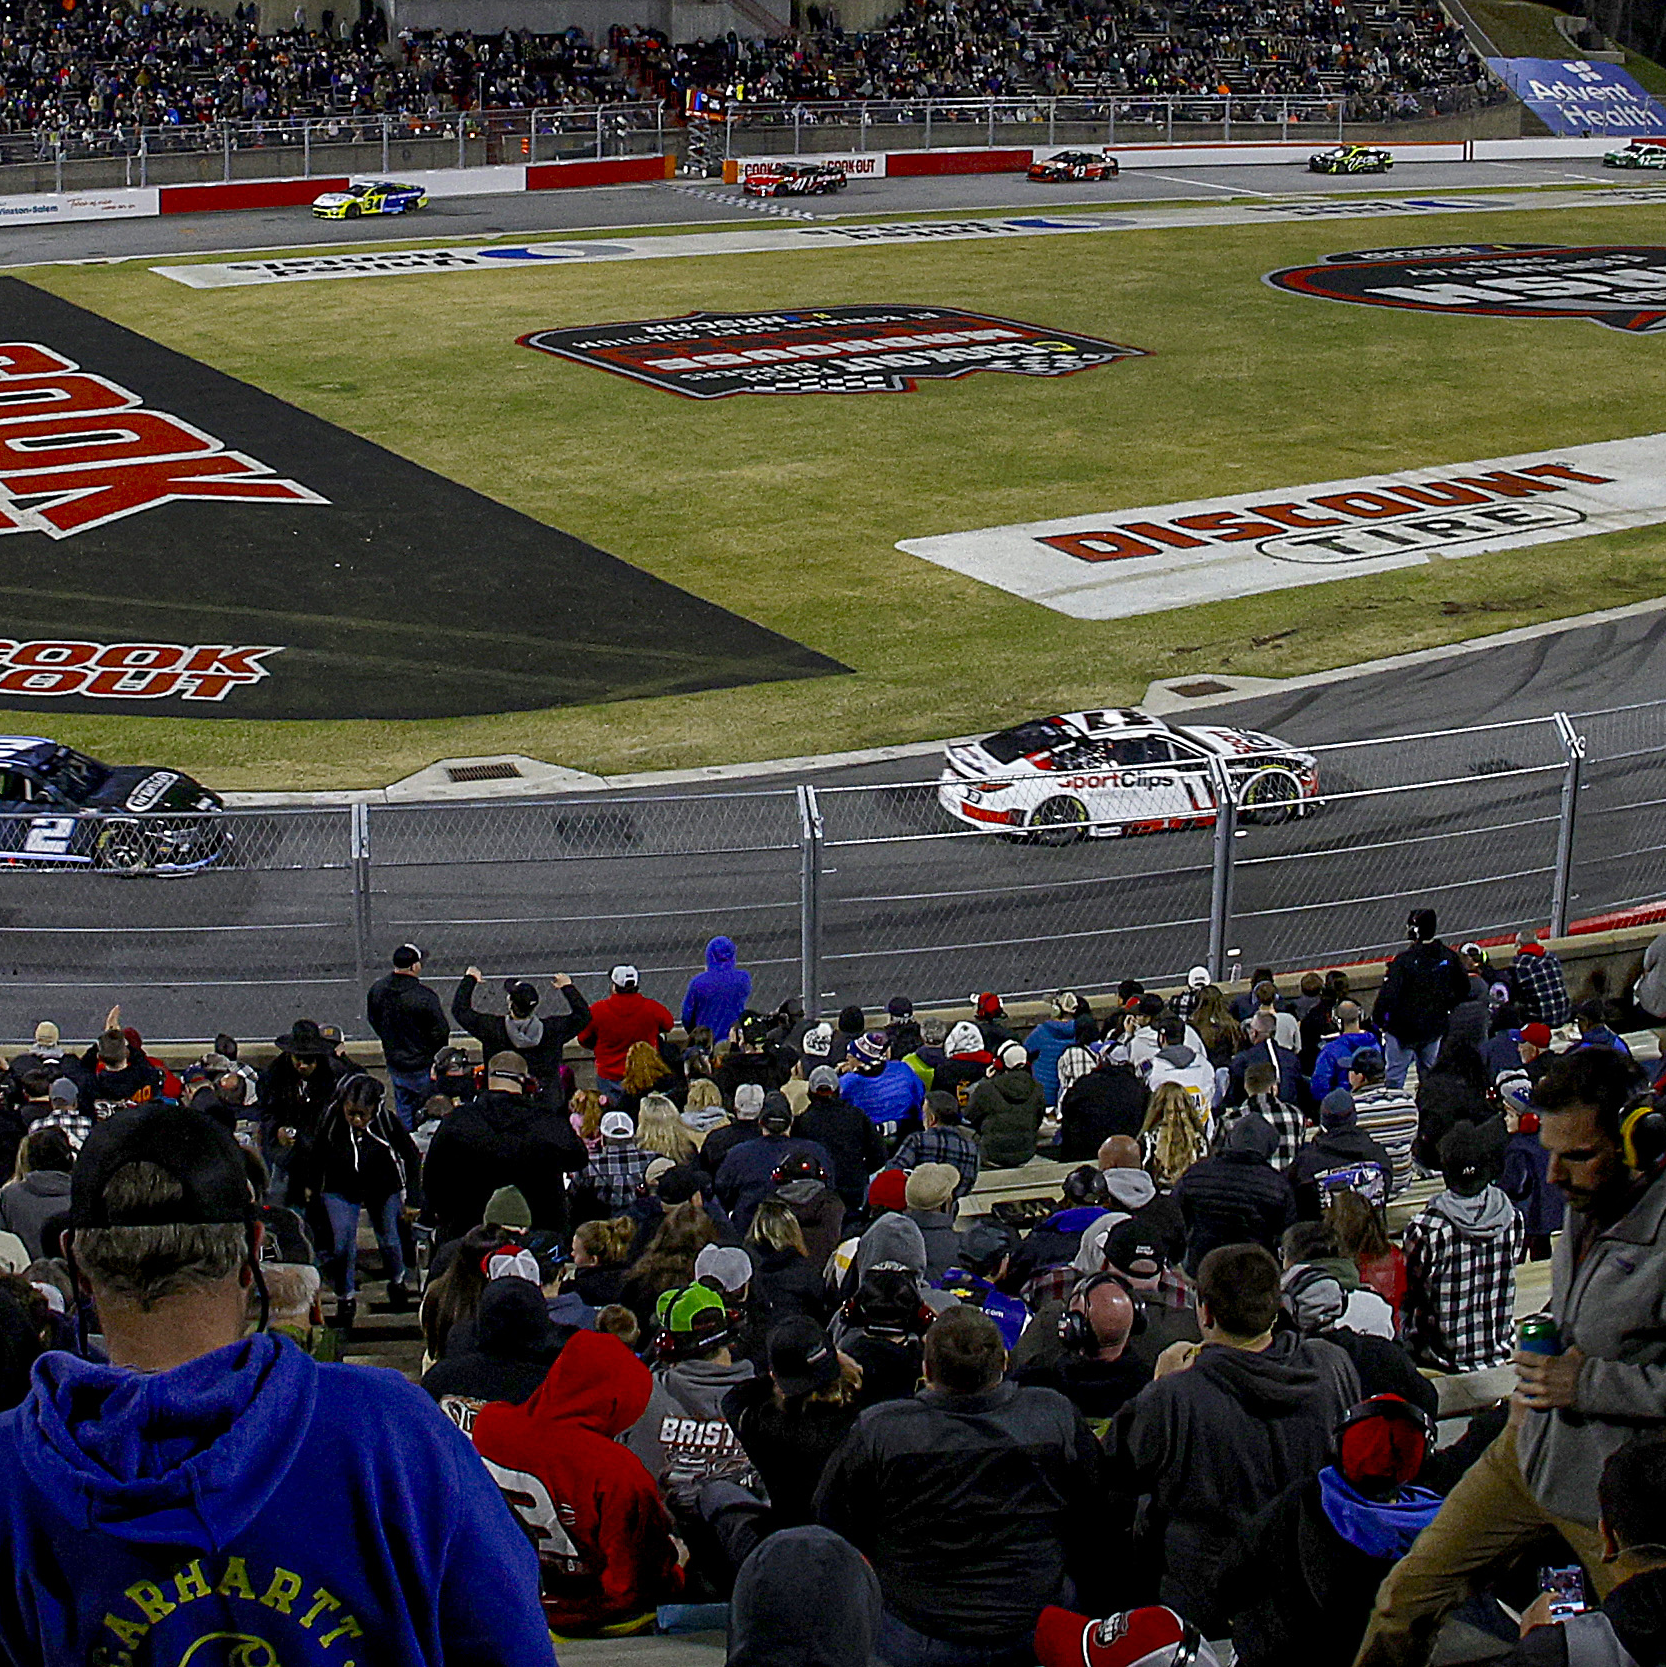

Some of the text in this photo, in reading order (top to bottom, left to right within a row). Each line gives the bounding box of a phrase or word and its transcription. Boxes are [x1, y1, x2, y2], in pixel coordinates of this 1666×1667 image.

[1528, 79, 1639, 102] Advent
[226, 251, 461, 272] Rentals
[265, 257, 480, 277] United
[638, 315, 784, 333] NASCAR
[642, 328, 1025, 372] MADHOUSE
[1034, 462, 1618, 564] DISCOUNT
[1289, 505, 1543, 557] TIRE
[24, 817, 76, 854] 2
